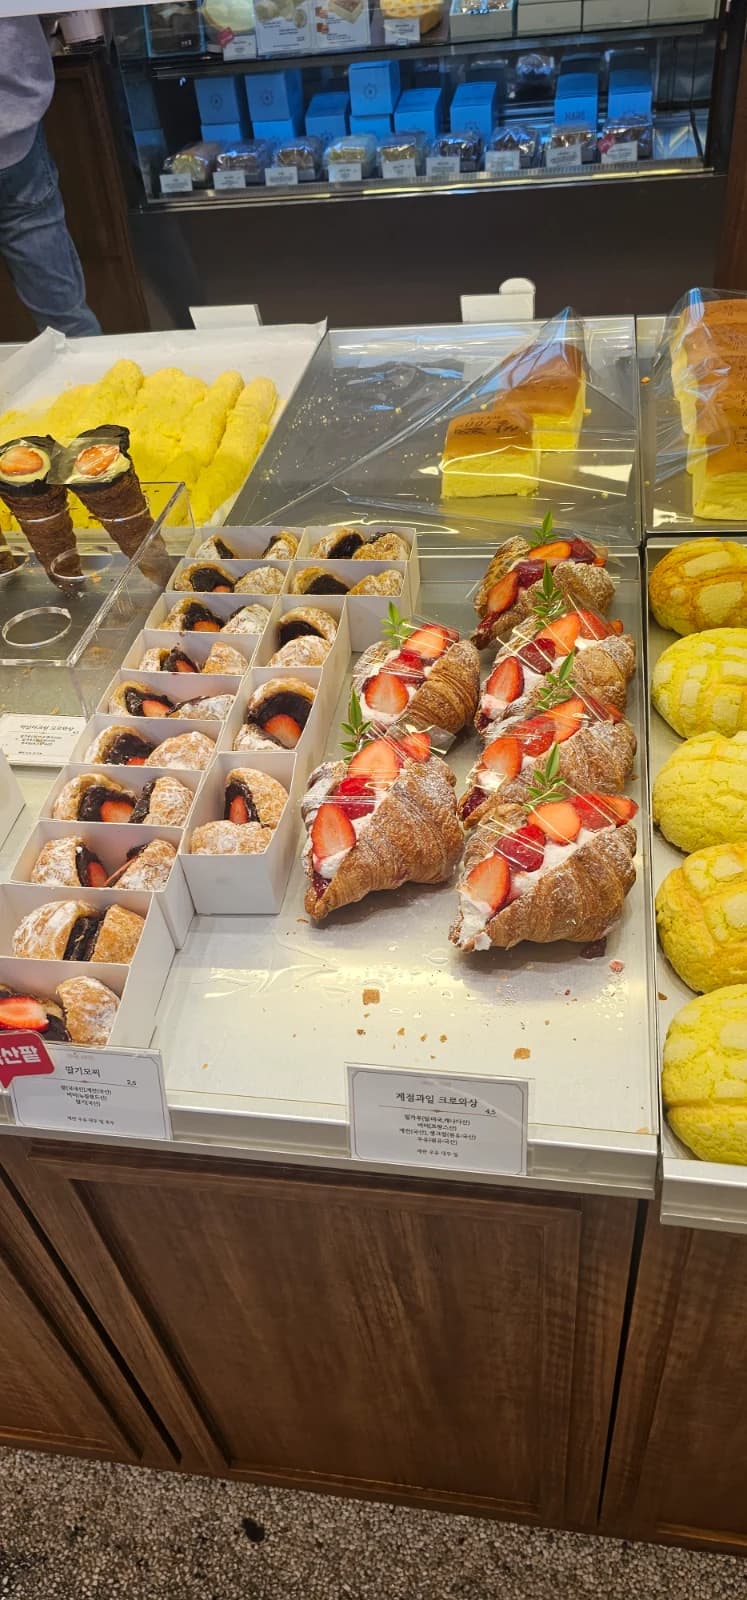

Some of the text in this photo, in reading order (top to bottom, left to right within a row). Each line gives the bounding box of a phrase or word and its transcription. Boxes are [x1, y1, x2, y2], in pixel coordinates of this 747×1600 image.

[0, 1045, 41, 1067] 산팥
[65, 1065, 101, 1078] 딸기모찌
[396, 1091, 479, 1108] 계절과일 크로와상
